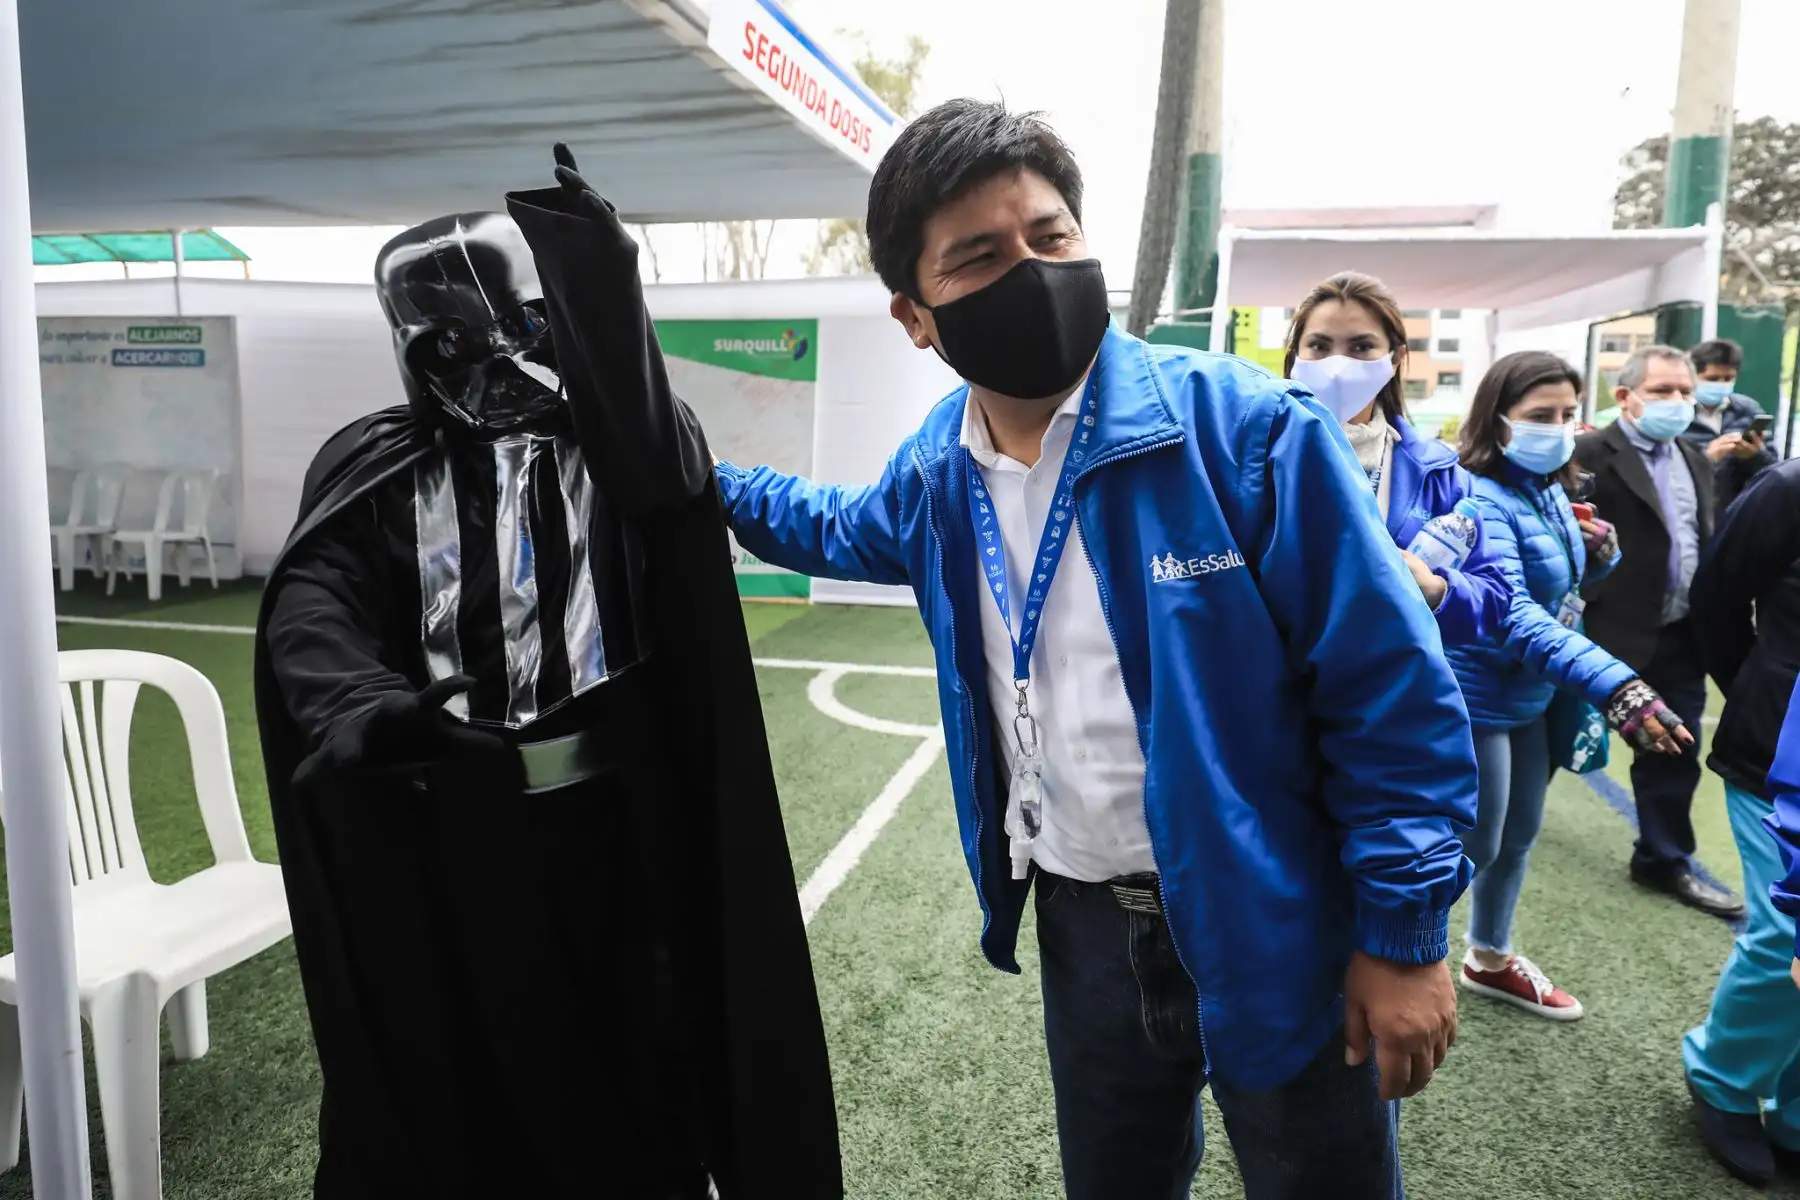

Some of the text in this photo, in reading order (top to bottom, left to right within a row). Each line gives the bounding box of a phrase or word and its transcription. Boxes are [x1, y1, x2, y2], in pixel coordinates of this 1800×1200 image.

[742, 21, 872, 153] SEGUNDA DOSIS
[129, 327, 200, 342] ALEJARNOS
[1187, 549, 1245, 577] EsSalu
